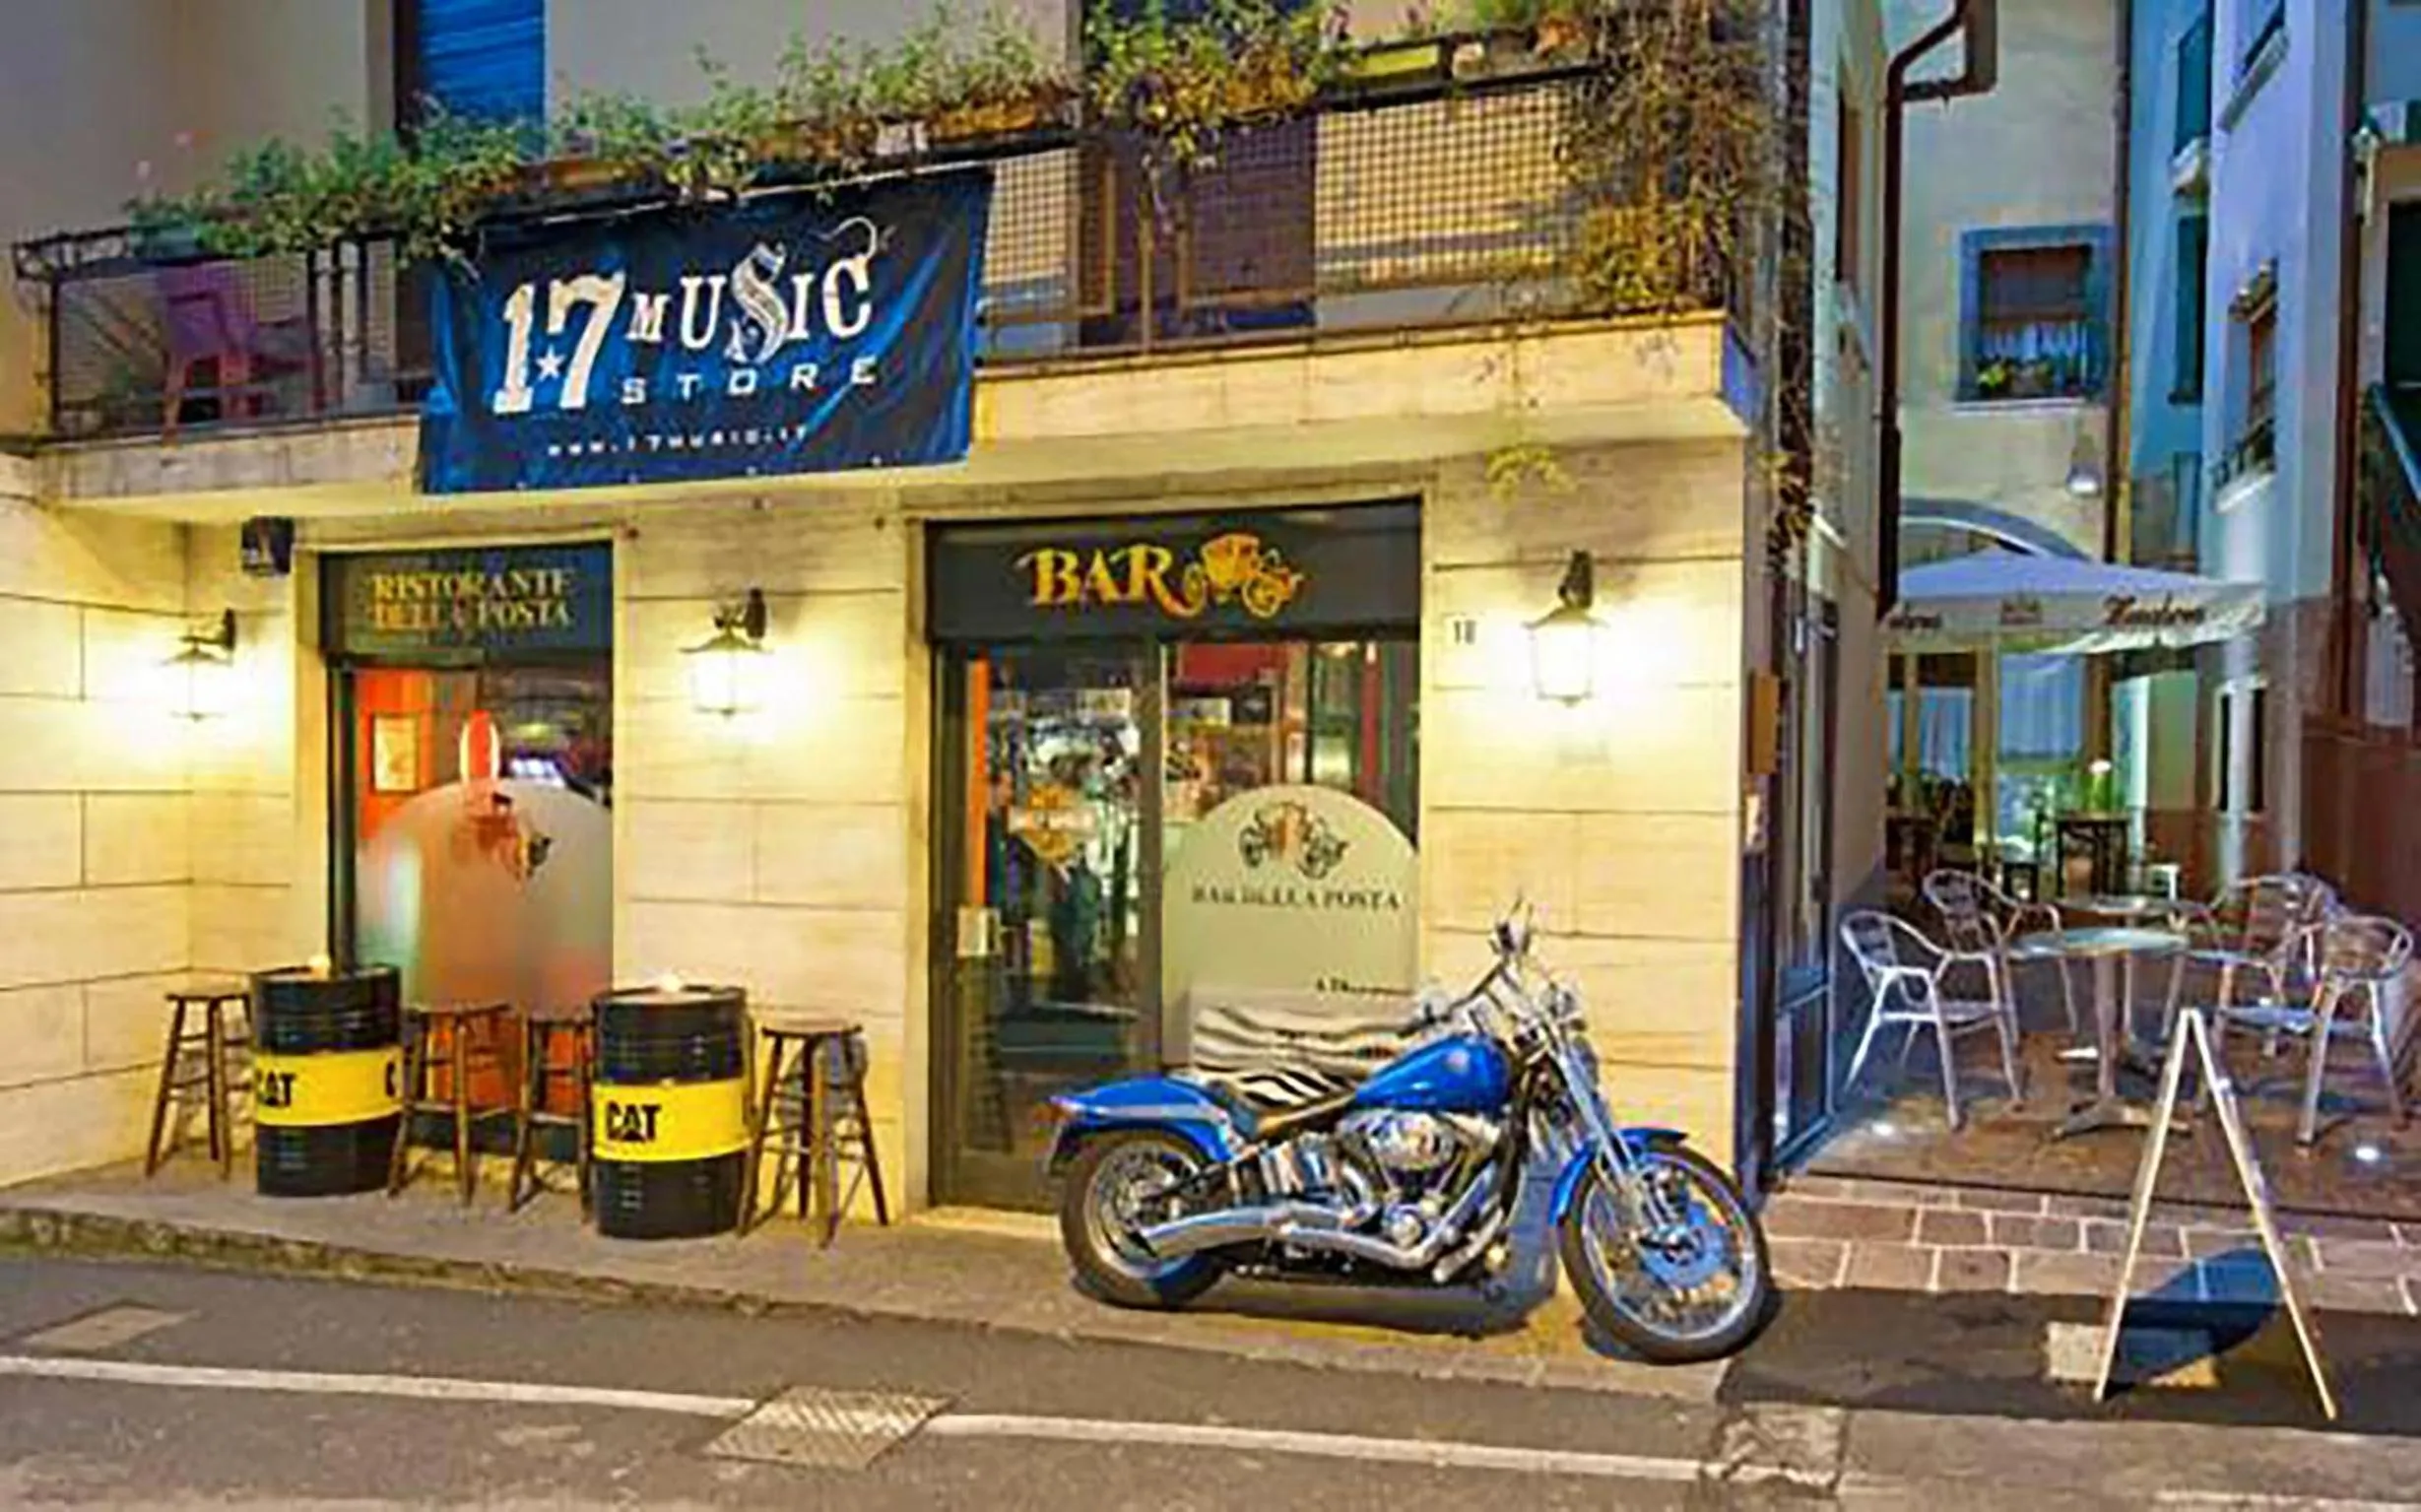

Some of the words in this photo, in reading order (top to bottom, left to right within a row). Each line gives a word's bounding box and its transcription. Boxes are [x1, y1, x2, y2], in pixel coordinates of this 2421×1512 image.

[493, 269, 626, 415] 17
[624, 217, 879, 364] MUSIC
[620, 356, 879, 405] STORE
[1014, 543, 1198, 617] BAR
[607, 1100, 662, 1143] CAT
